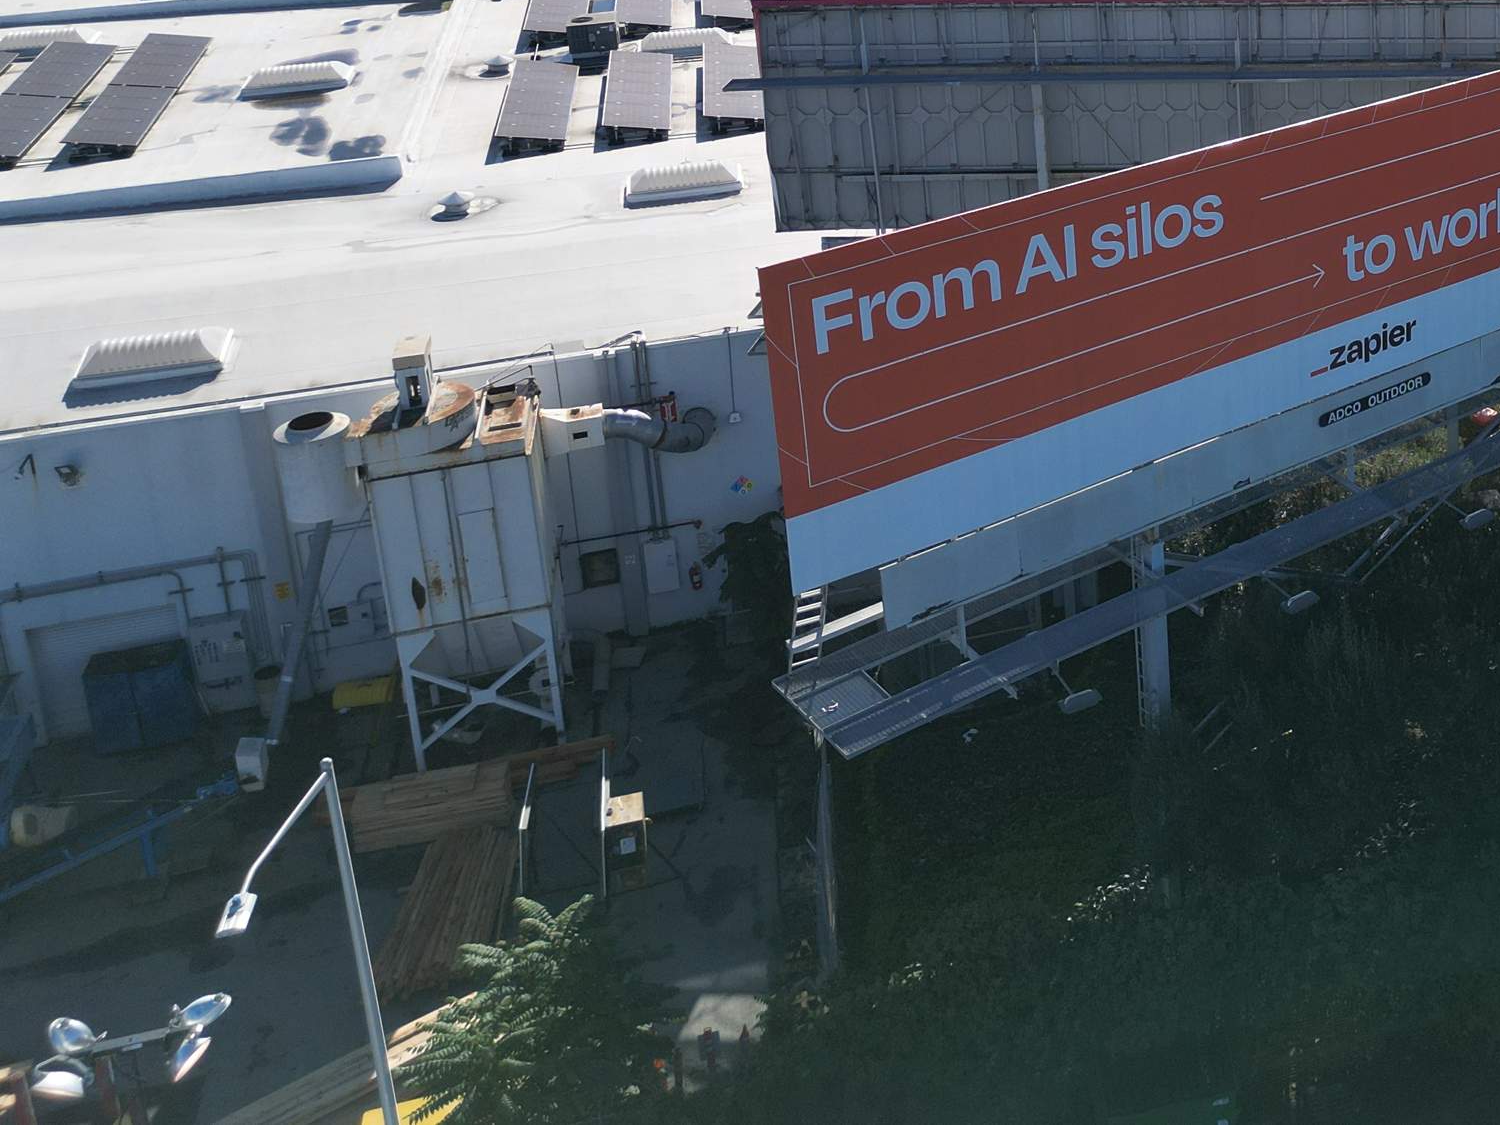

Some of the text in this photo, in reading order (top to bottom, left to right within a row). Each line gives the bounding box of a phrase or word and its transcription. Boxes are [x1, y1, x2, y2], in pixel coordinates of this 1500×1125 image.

[811, 195, 1225, 355] From AI silos
[1343, 234, 1396, 282] to
[1327, 376, 1423, 424] ADCO OUTDOOR
